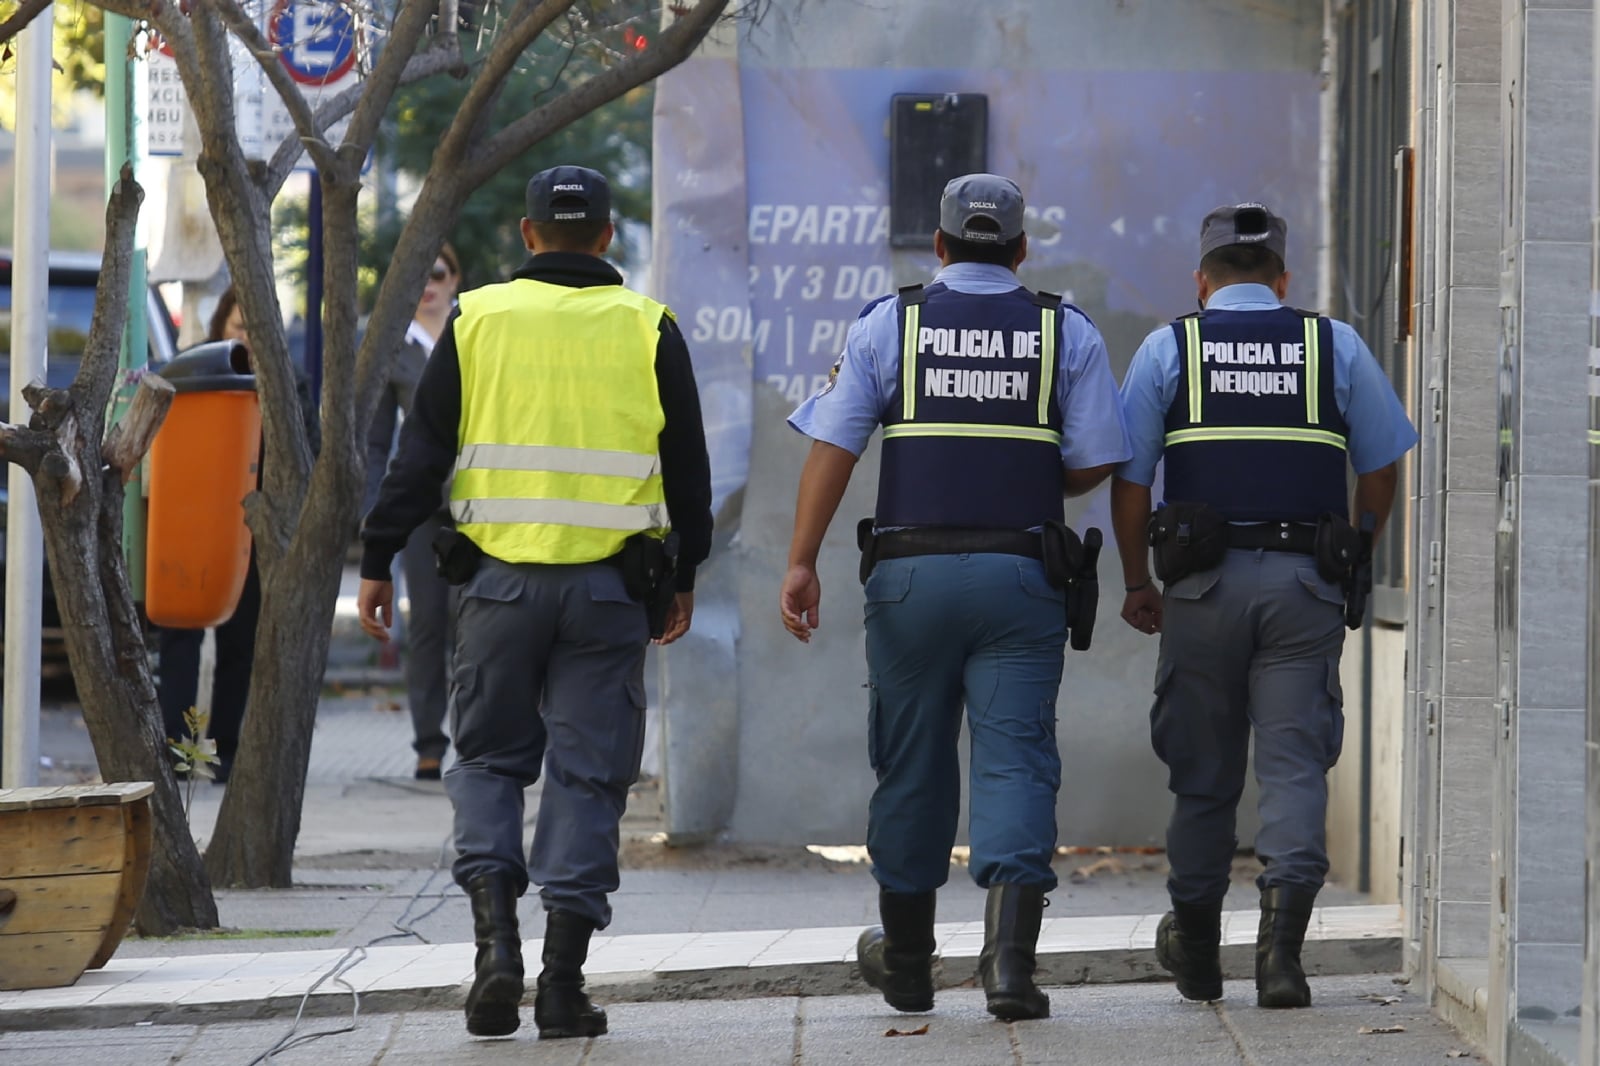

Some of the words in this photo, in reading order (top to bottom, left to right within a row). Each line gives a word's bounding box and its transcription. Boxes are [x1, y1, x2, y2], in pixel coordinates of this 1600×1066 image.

[294, 2, 335, 65] E
[969, 201, 997, 209] POLICIA
[749, 204, 891, 245] EPARTA
[773, 264, 795, 299] Y
[801, 265, 825, 300] 3
[918, 327, 1006, 358] POLICIA
[1012, 330, 1041, 359] DE
[1202, 341, 1276, 365] POLICIA
[1280, 342, 1304, 365] DE
[924, 367, 1029, 403] NEUQUEN
[1210, 370, 1298, 397] NEUQUEN
